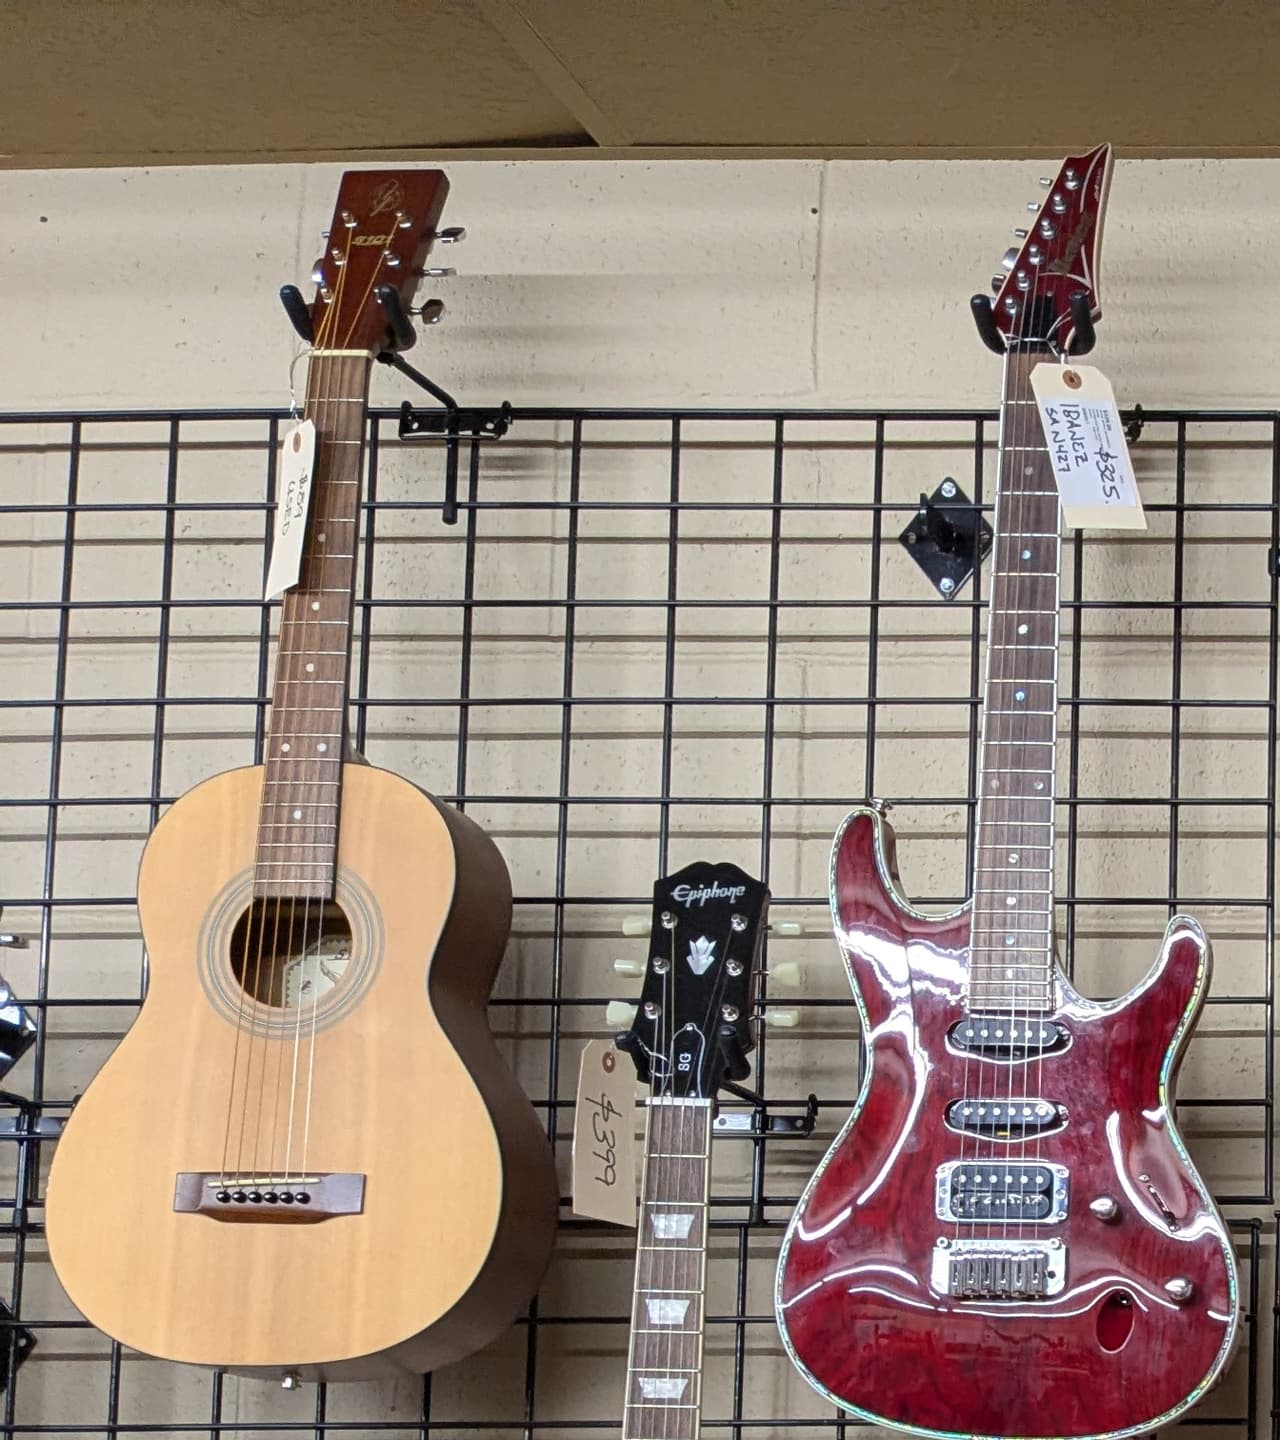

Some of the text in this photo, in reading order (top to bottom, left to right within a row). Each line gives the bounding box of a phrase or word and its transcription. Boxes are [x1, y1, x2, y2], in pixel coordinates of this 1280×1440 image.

[1059, 404, 1088, 467] IBANEZ
[282, 480, 296, 536] USED
[670, 881, 746, 908] Epiphone
[678, 1051, 692, 1072] SG
[586, 1094, 622, 1186] $399
